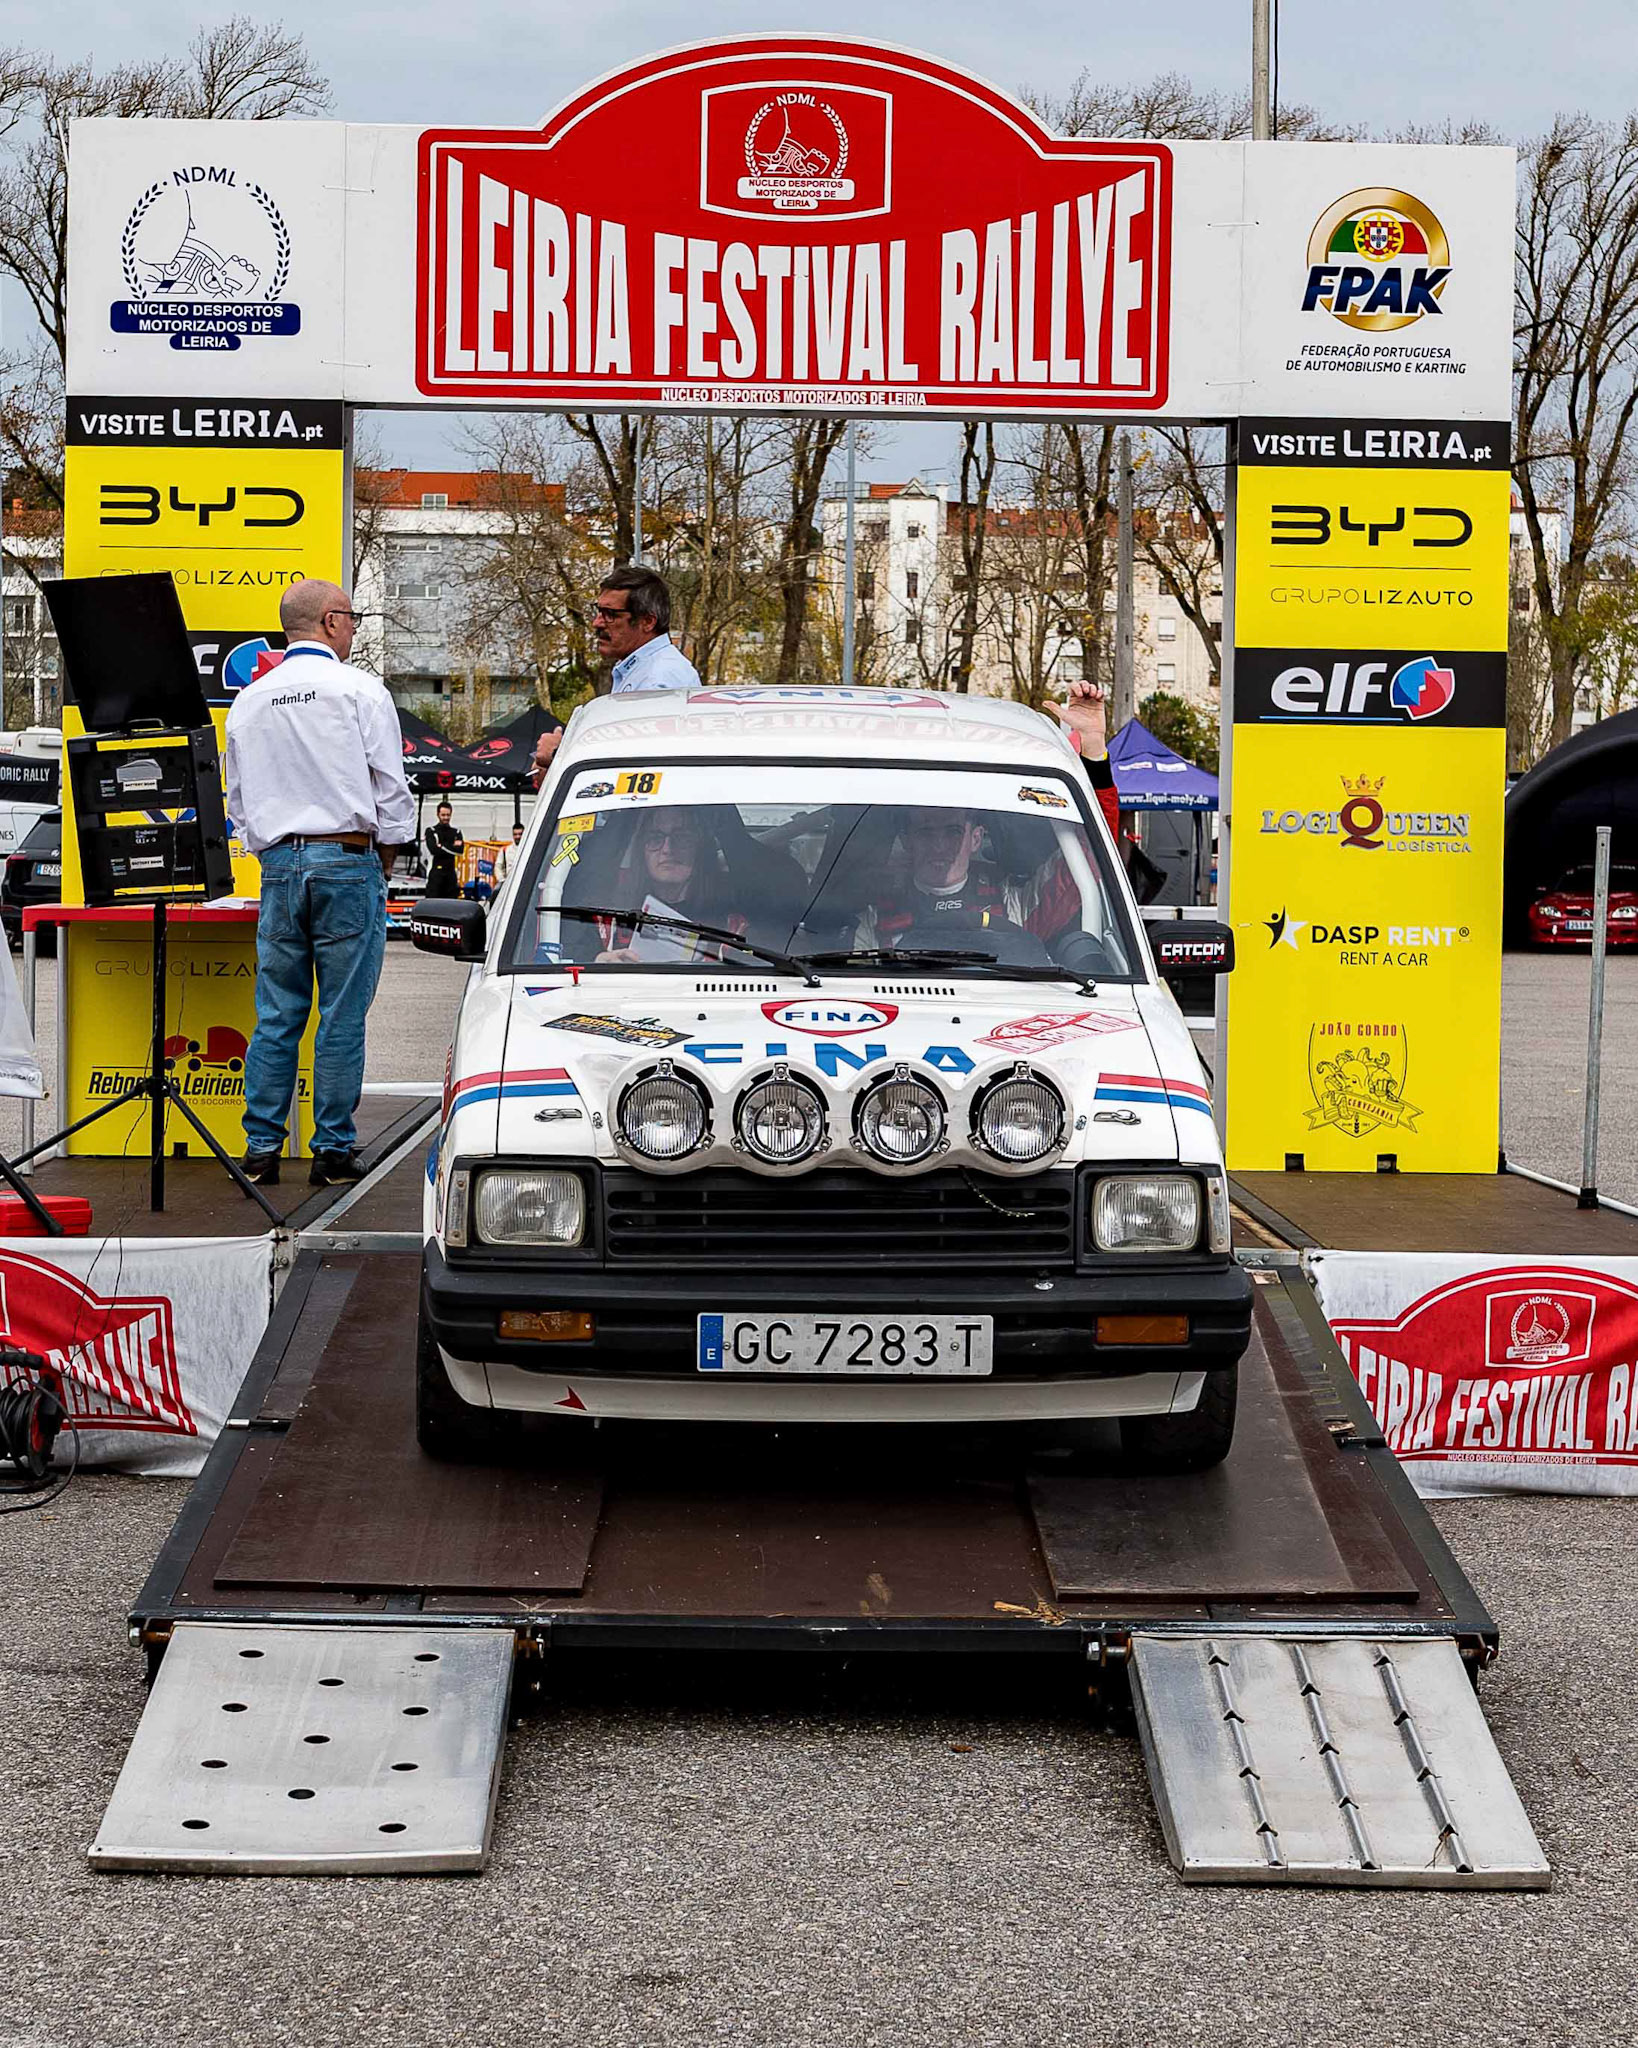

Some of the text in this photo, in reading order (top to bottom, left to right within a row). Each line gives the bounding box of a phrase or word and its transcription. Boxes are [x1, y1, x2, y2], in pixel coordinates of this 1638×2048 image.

[776, 93, 817, 108] NDML
[173, 166, 236, 187] NDML
[749, 178, 843, 189] NÚCLEO DESPORTOS
[756, 189, 836, 198] MOTORIZADOS DE
[782, 199, 810, 207] LEIRIA
[444, 155, 1146, 386] LEIRIA FESTIVAL RALLYE
[1301, 265, 1453, 316] FPAK
[127, 301, 283, 317] NÚCLEO DESPORTOS
[139, 319, 272, 333] MOTORIZADOS DE
[181, 336, 229, 348] LEIRIA
[1301, 344, 1451, 359] FEDERAÇÃO PORTUGUESA
[1286, 360, 1467, 374] DE AUTOMOBILISMO E KARTING
[661, 388, 926, 406] NUCLEO DESPORTOS MOTORIZADOS DE LEIRIA
[80, 408, 323, 441] VISITE LEIRIA.pt
[1252, 429, 1492, 462] VISITE LEIRIA.pt
[100, 484, 305, 527] BYD
[1271, 504, 1473, 548] BYD
[1270, 588, 1473, 606] GRUPOLIZAUTO
[1270, 662, 1387, 713] elf
[271, 690, 316, 706] ndml.pt
[23, 767, 50, 782] RALLY
[455, 774, 507, 789] 24MX
[626, 772, 656, 794] 18
[1260, 796, 1470, 849] LOGIQUEEN
[1386, 840, 1472, 853] LOGÍSTICA
[934, 899, 963, 911] RRS
[1311, 925, 1379, 946] DASP
[1161, 943, 1225, 956] CATCOM
[1339, 952, 1429, 967] RENT A CAR
[785, 1011, 882, 1023] FINA
[1319, 1021, 1397, 1037] JOÃO GORDO
[183, 1072, 246, 1096] Leirien
[200, 1098, 242, 1106] SOCORRO
[1528, 1296, 1553, 1306] NDML
[733, 1321, 982, 1368] GC 7283 T
[706, 1348, 716, 1360] E
[1445, 1373, 1594, 1451] FESTIVAL
[1476, 1454, 1515, 1463] DESPORTOS
[1516, 1455, 1564, 1464] MOTORIZADOS
[1565, 1456, 1574, 1464] DE
[1575, 1456, 1597, 1464] LEIRIA
